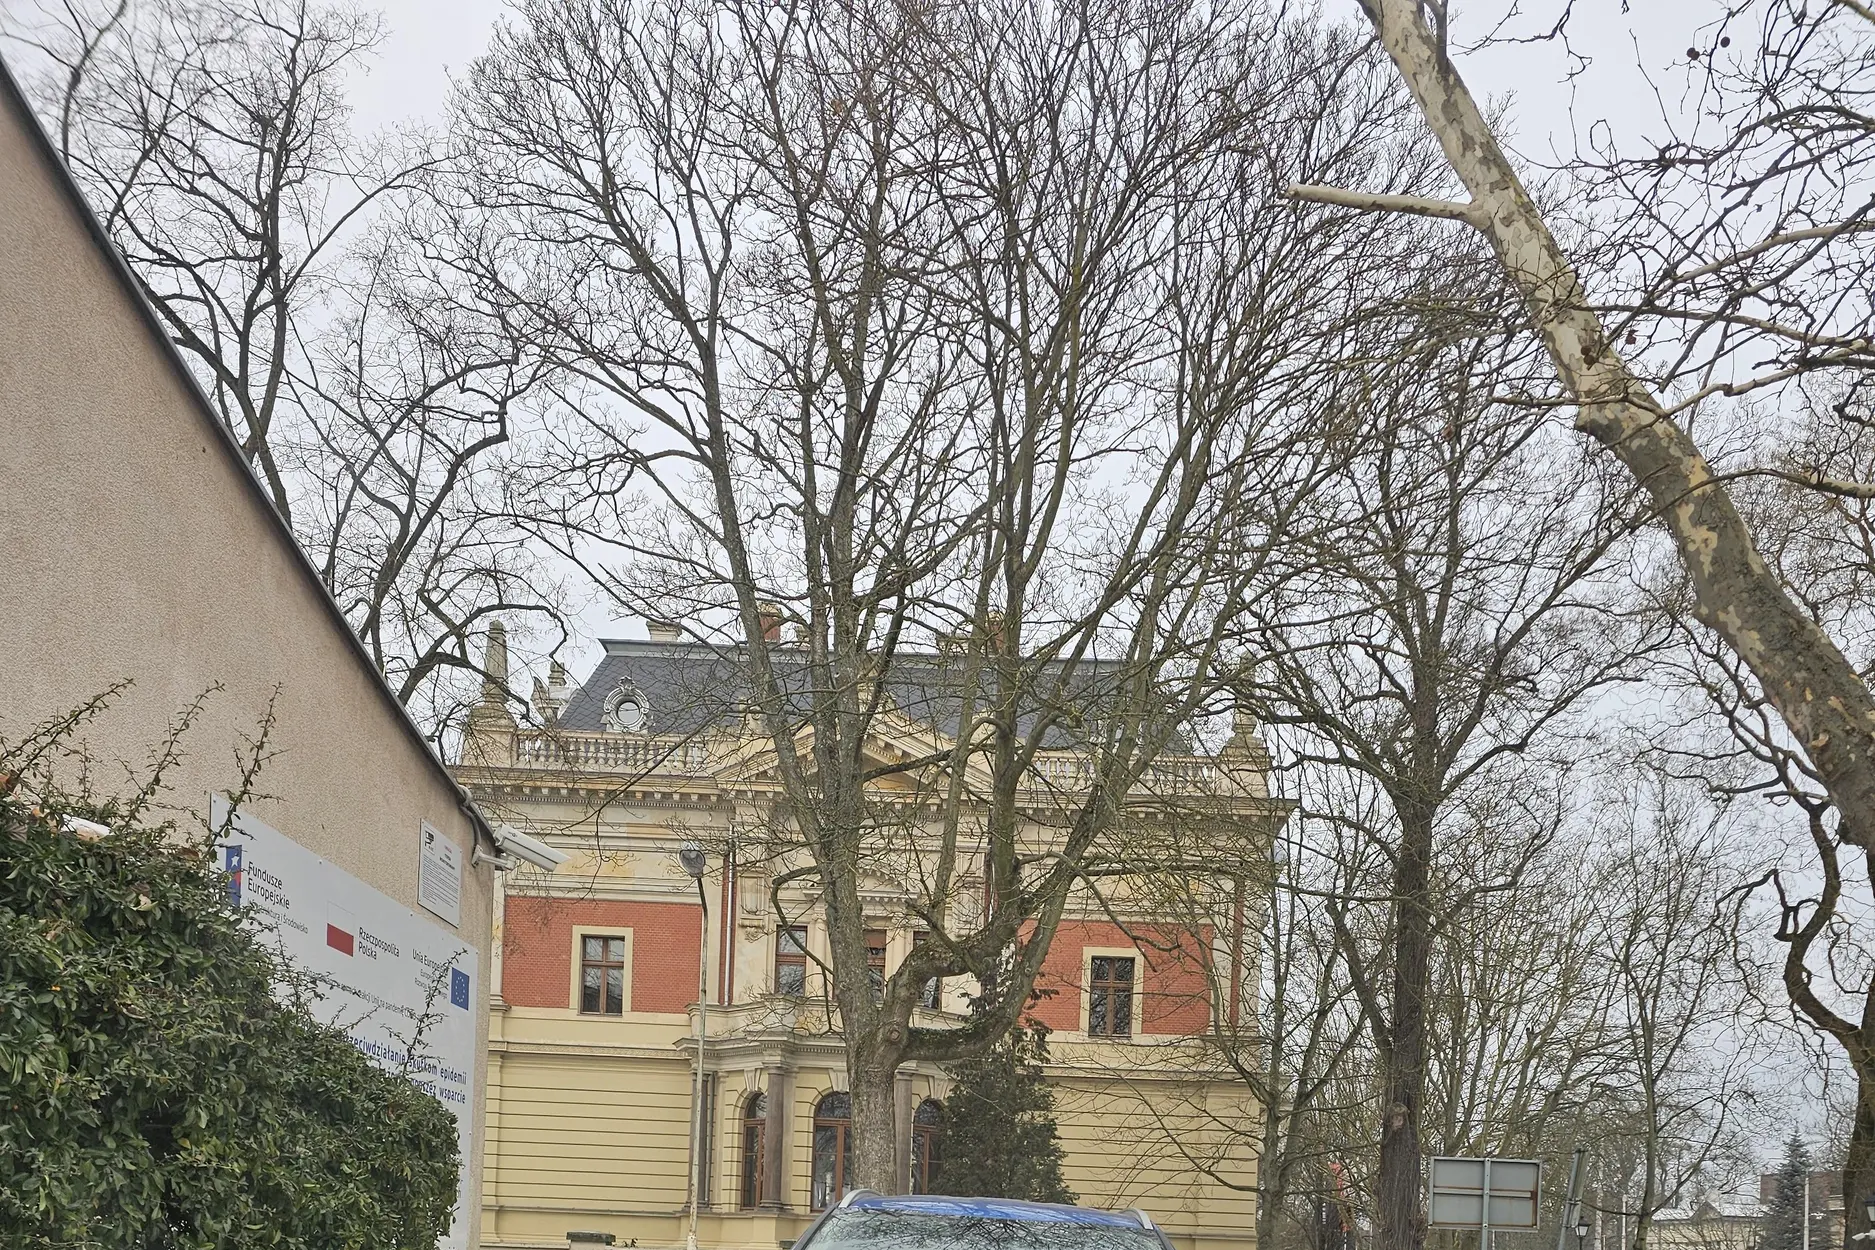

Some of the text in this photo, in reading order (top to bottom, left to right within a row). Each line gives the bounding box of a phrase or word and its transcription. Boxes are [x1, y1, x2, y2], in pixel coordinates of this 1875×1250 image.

[247, 861, 282, 890] Fundusze
[247, 877, 290, 910] Europejskie
[358, 927, 400, 958] Rzeczpospolita
[358, 940, 377, 960] Polska
[412, 948, 424, 964] Unia
[440, 1066, 467, 1085] epidemii
[439, 1087, 466, 1104] wsparcie
